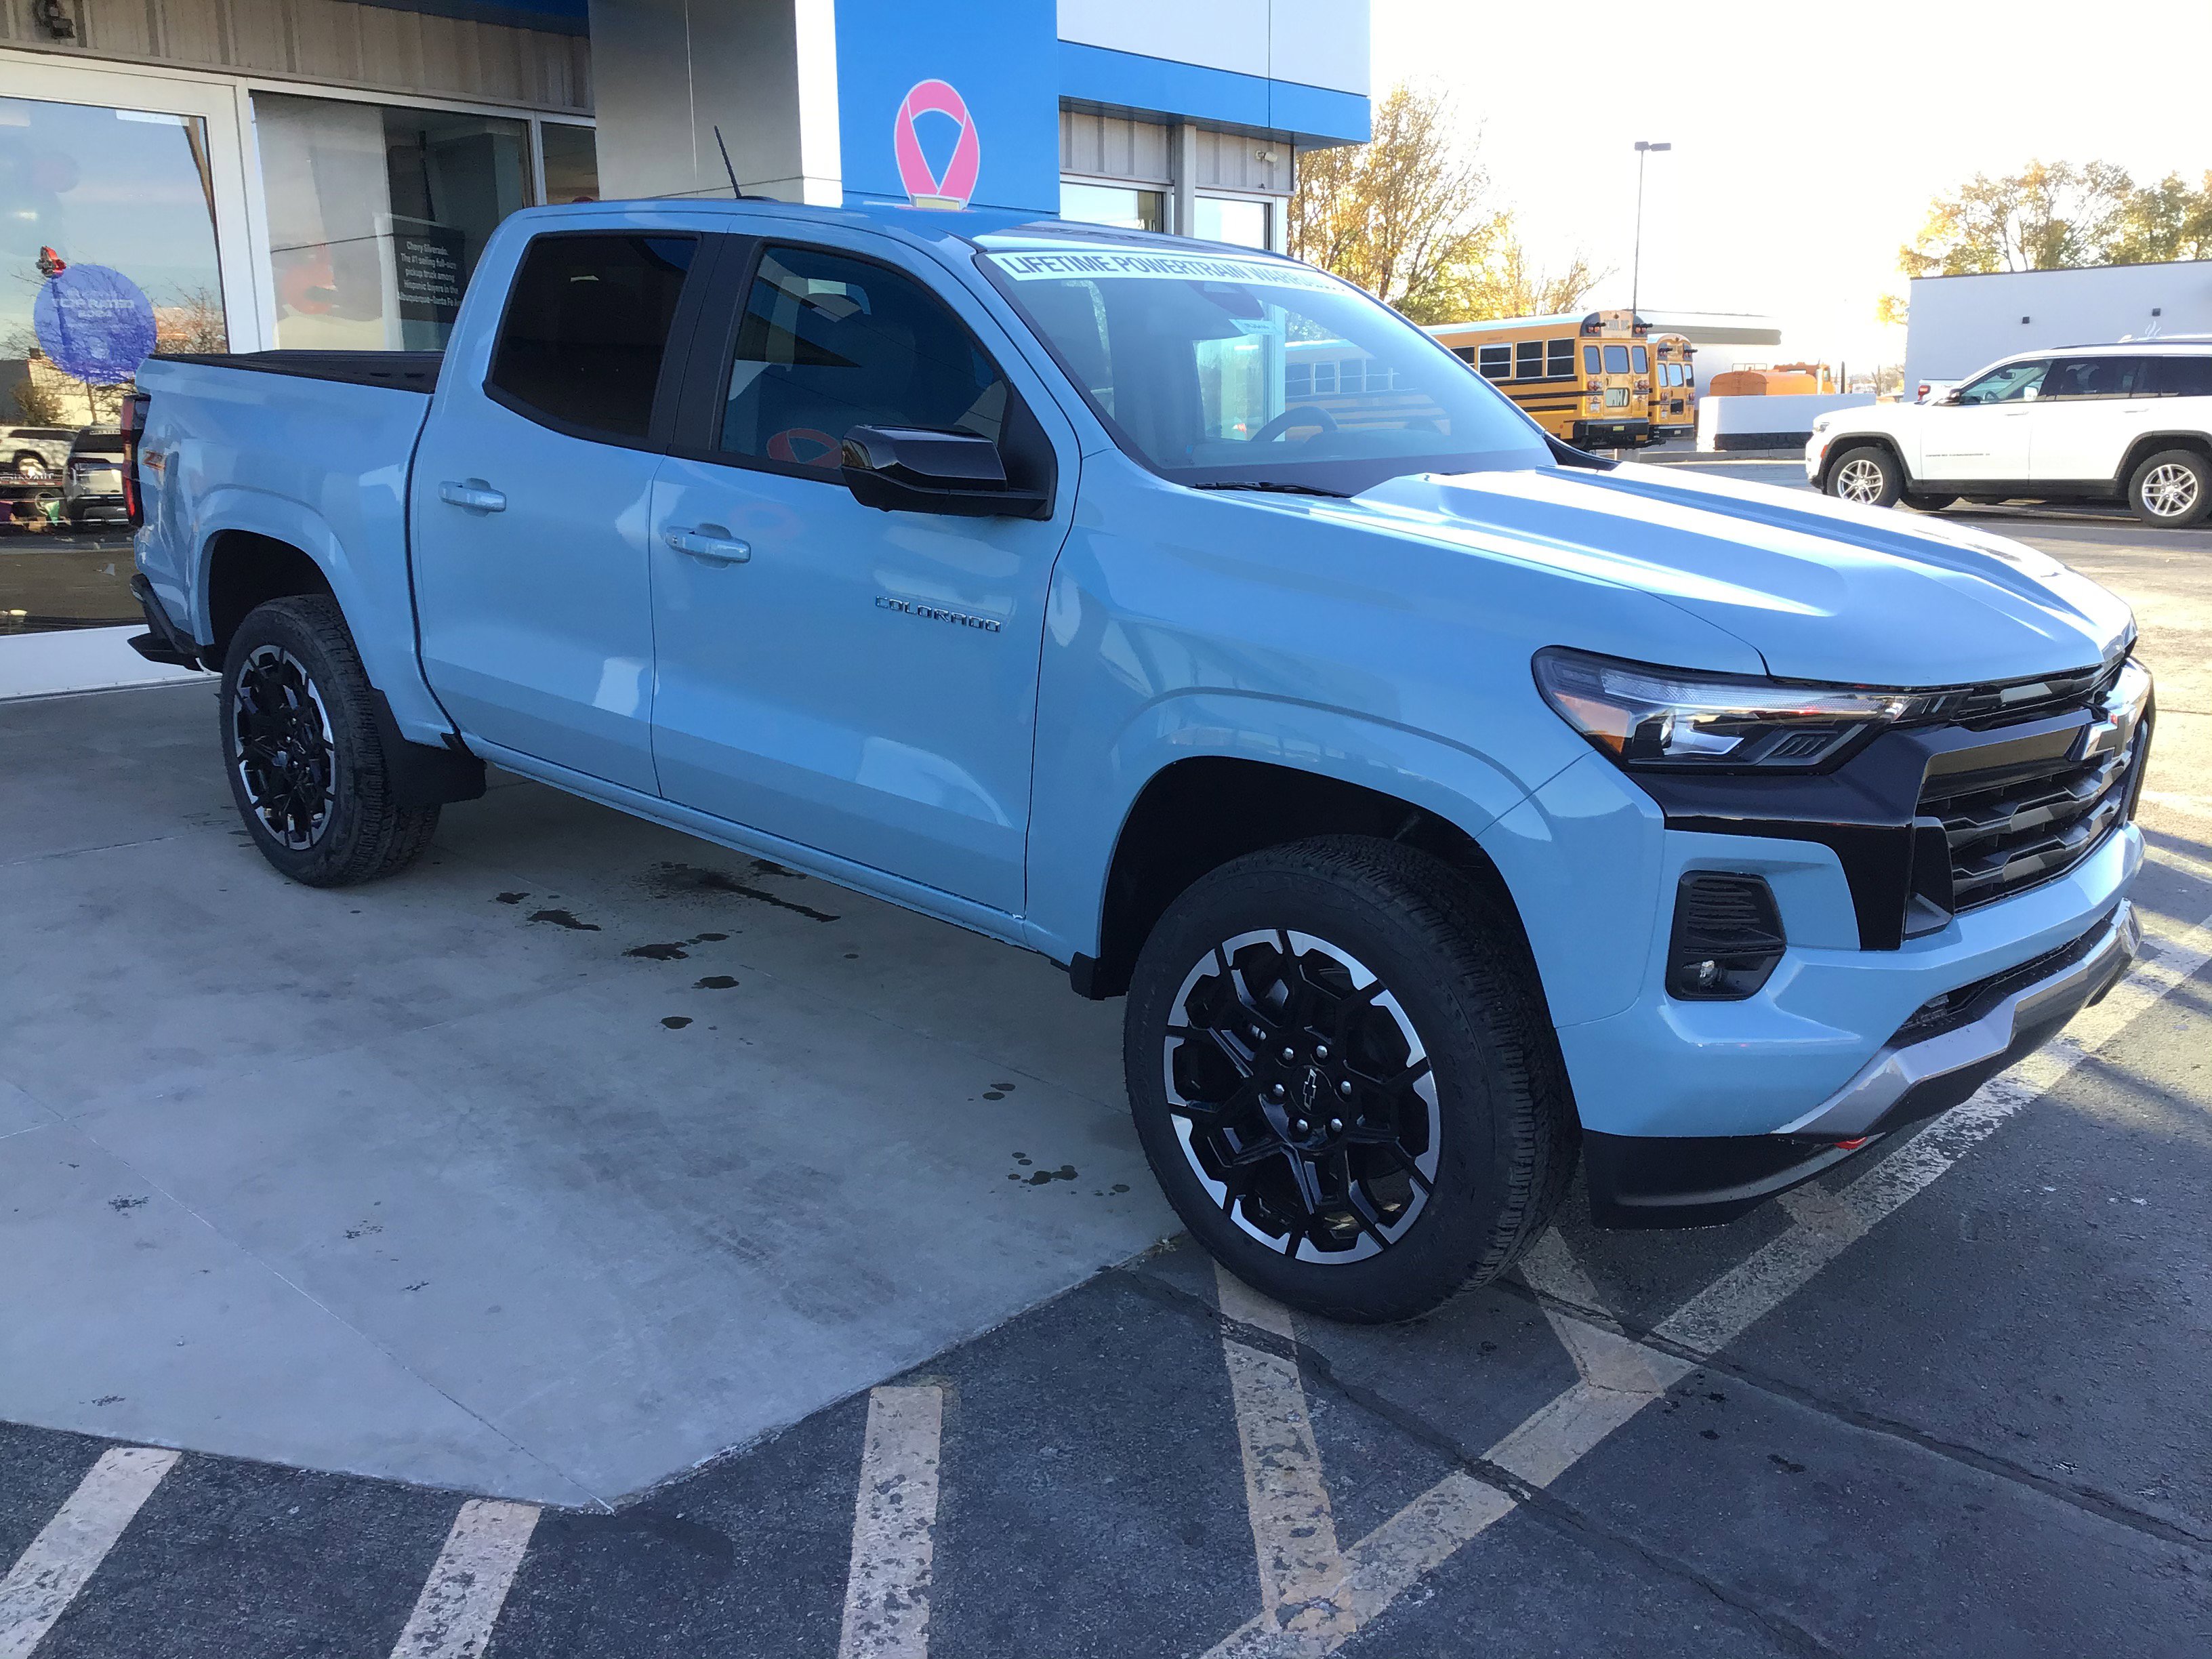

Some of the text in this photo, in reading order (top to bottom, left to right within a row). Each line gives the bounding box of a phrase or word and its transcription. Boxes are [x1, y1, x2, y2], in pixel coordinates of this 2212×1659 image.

[407, 241, 423, 253] Chevy
[401, 253, 411, 263] The
[419, 257, 435, 268] selling
[1001, 255, 1120, 274] LIFETIME
[1110, 257, 1252, 279] POWERTRAIN
[405, 267, 455, 283] pickup truck among
[404, 279, 459, 294] Hispanic buyers in the
[875, 595, 1002, 633] COLORADO
